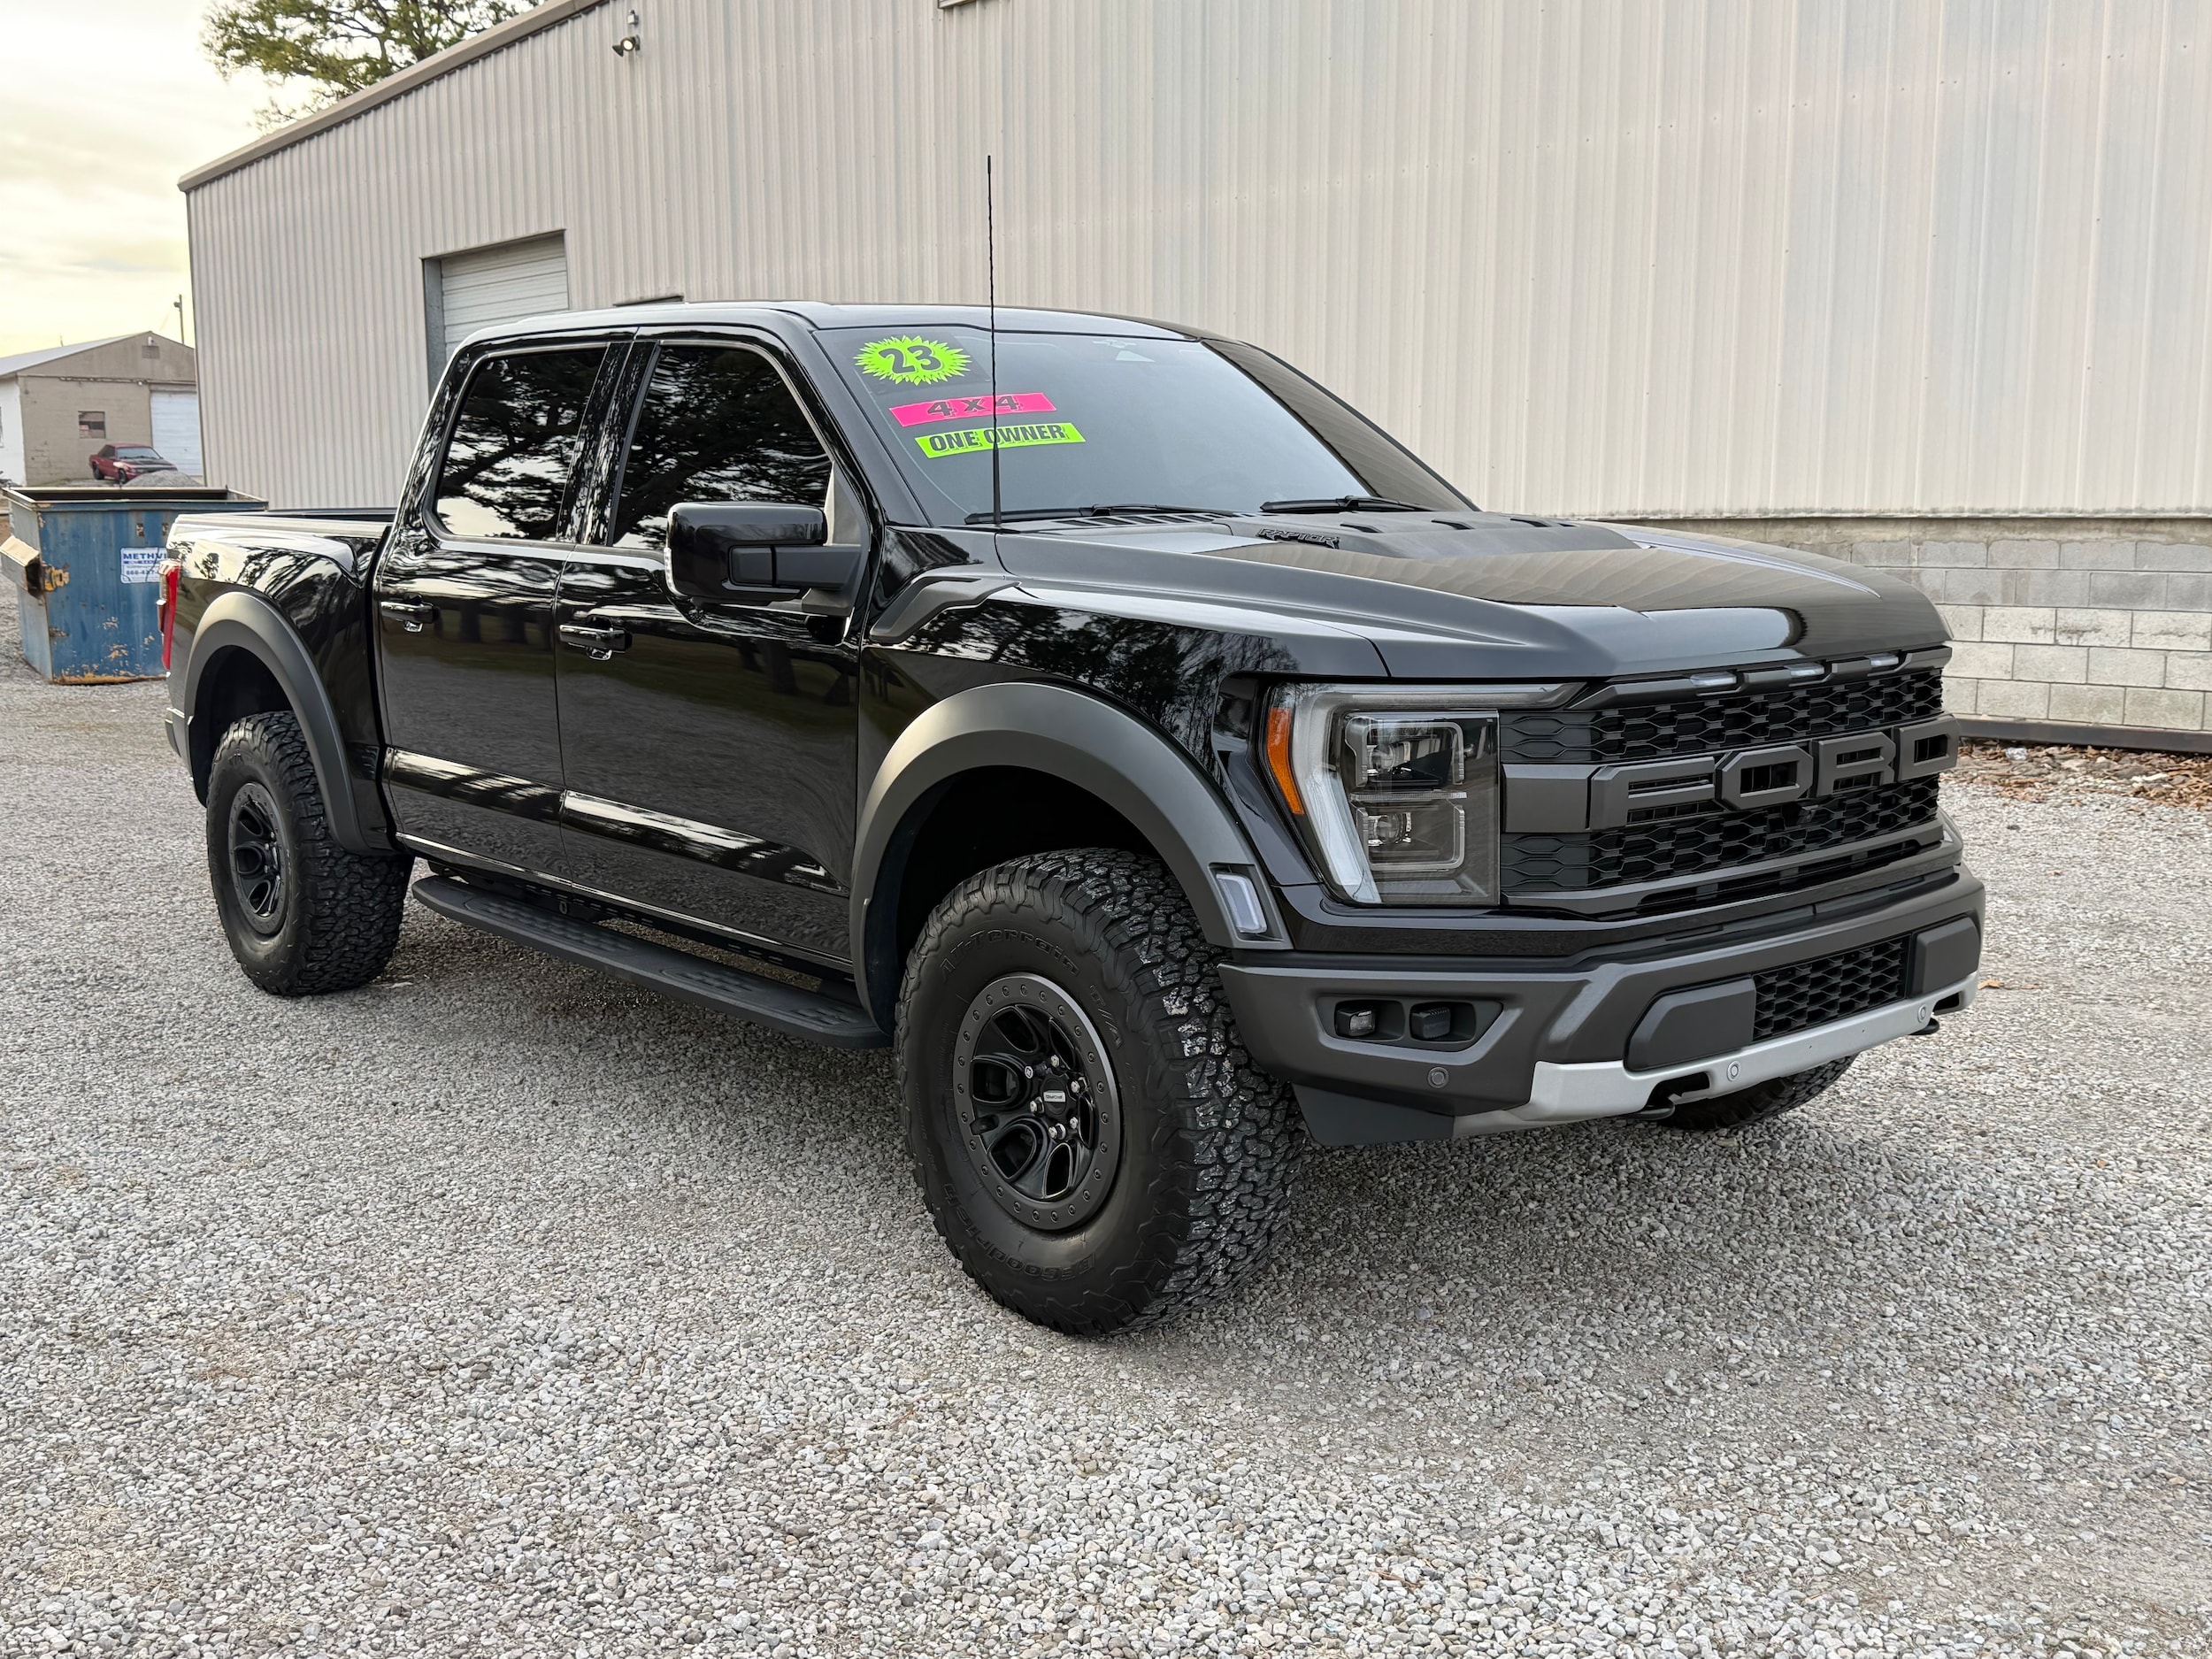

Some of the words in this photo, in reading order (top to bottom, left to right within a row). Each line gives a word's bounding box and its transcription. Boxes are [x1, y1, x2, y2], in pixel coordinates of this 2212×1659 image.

[879, 345, 941, 373] 23
[929, 431, 982, 452] ONE
[983, 424, 1068, 444] OWNER
[1256, 528, 1340, 549] RAPTOR
[1589, 713, 1959, 832] FORD
